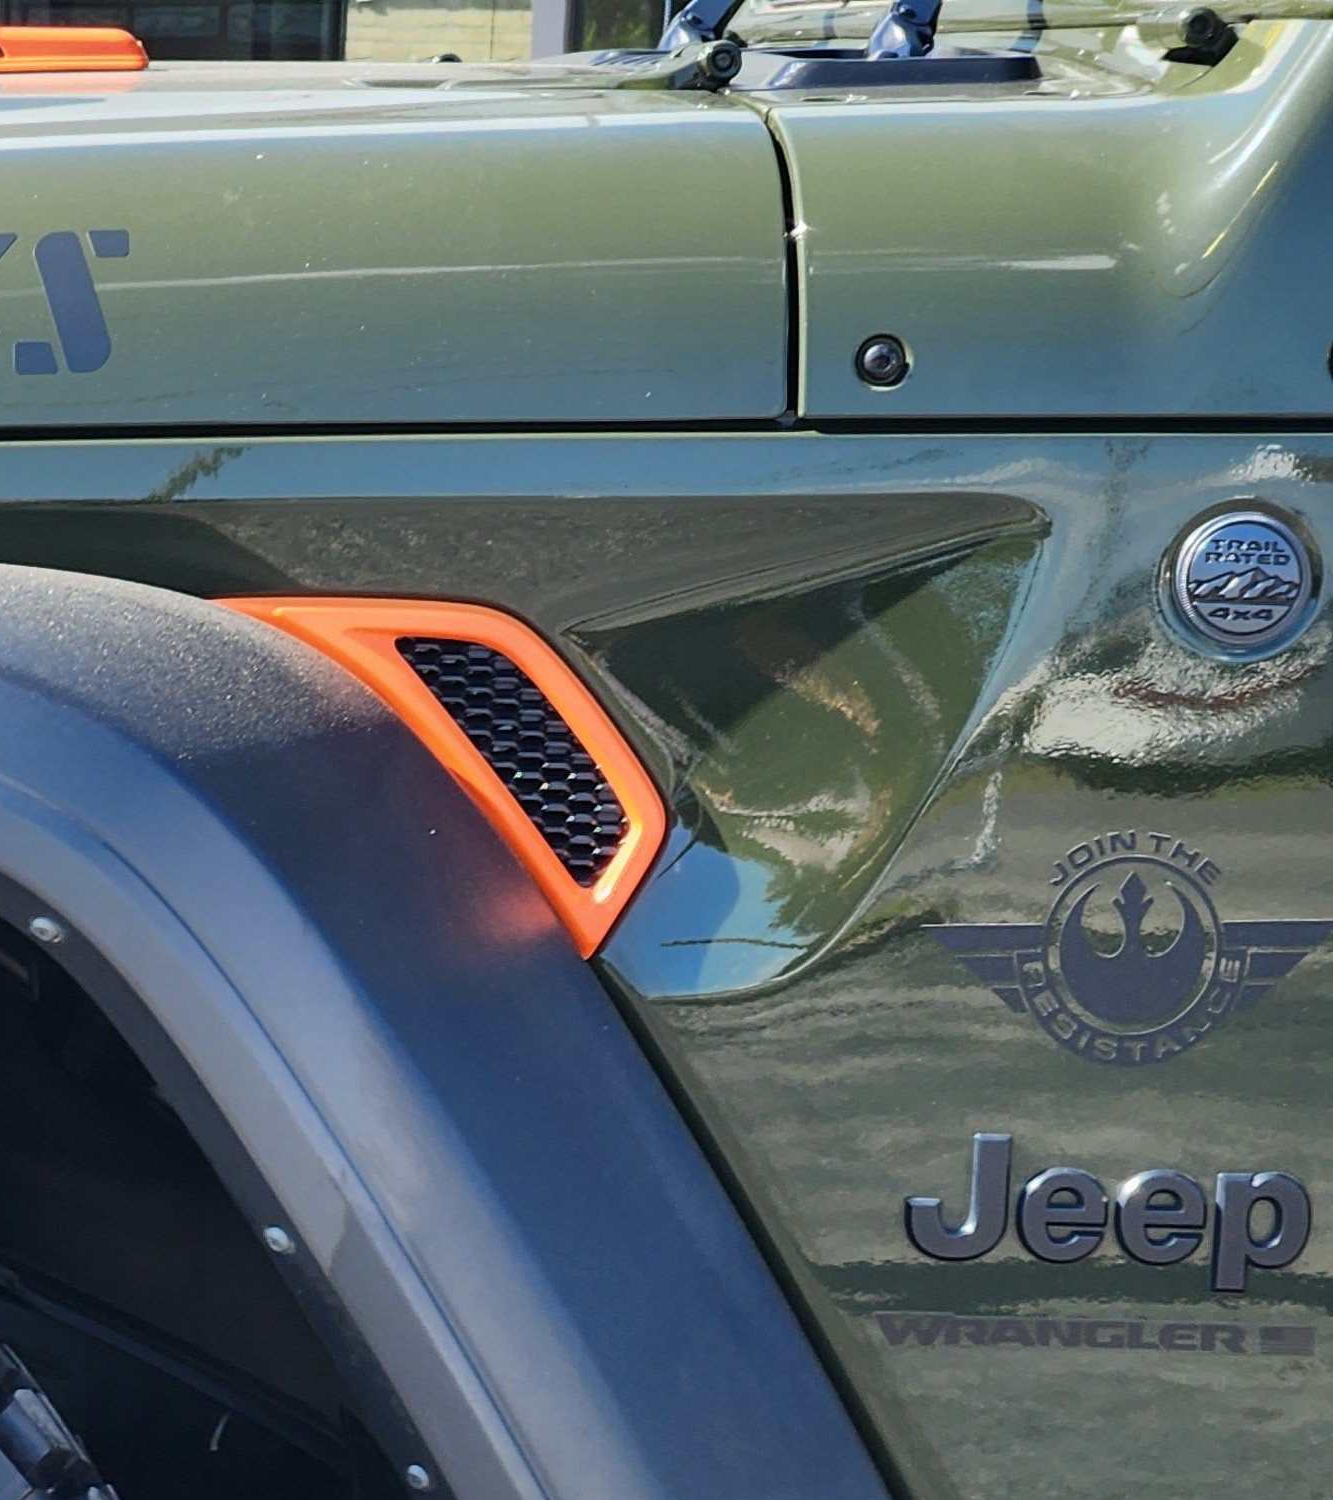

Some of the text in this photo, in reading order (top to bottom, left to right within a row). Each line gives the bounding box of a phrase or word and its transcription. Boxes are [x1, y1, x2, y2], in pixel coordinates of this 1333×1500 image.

[1204, 551, 1291, 567] RATED
[1210, 537, 1286, 554] TRAIL
[1207, 606, 1275, 623] 4x4
[1049, 829, 1222, 887] JOIN THE
[1020, 959, 1241, 1063] RESISTANCE
[904, 1132, 1312, 1292] Jeep
[873, 1311, 1247, 1355] WRANGLER
